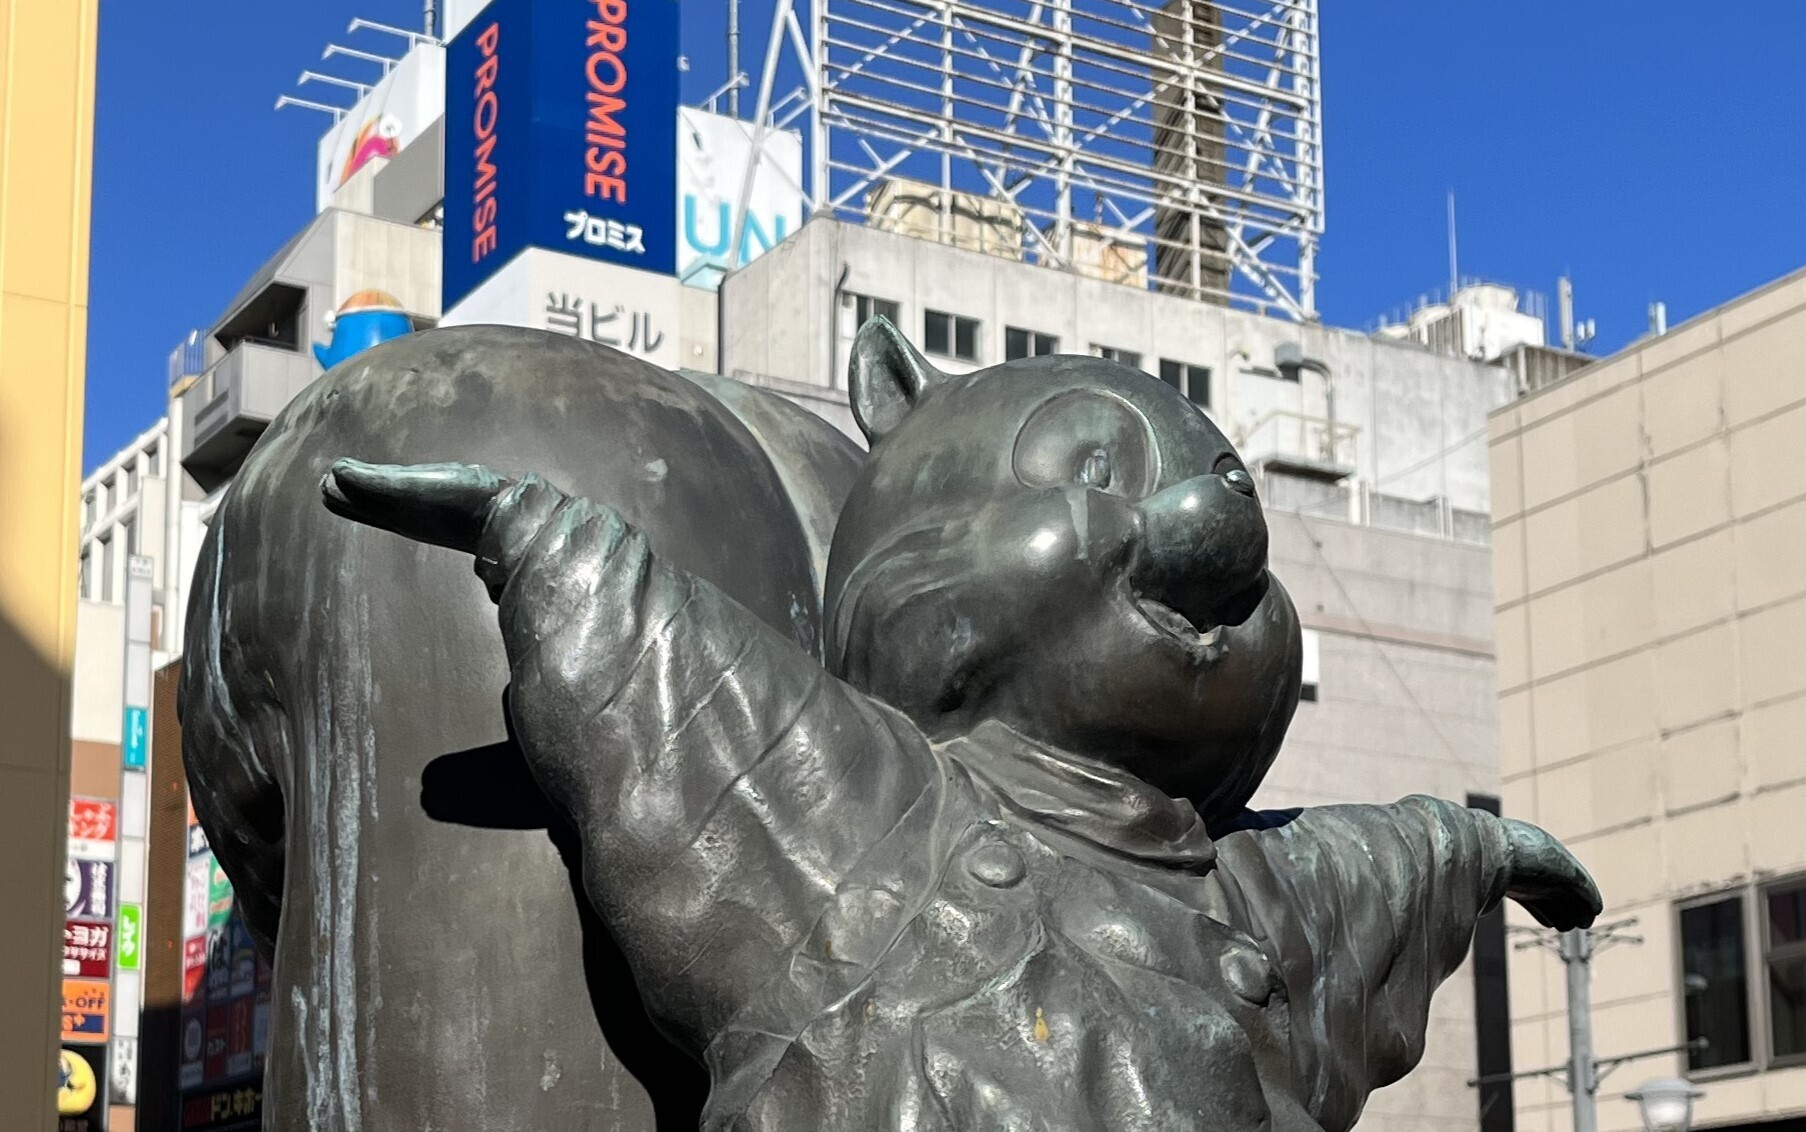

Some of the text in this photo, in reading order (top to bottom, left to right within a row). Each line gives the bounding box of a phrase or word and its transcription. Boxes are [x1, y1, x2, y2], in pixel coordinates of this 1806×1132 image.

[472, 22, 498, 262] PROMISE
[585, 0, 627, 204] PROMISE
[563, 209, 646, 254] プロミス
[546, 291, 665, 353] 当ビル
